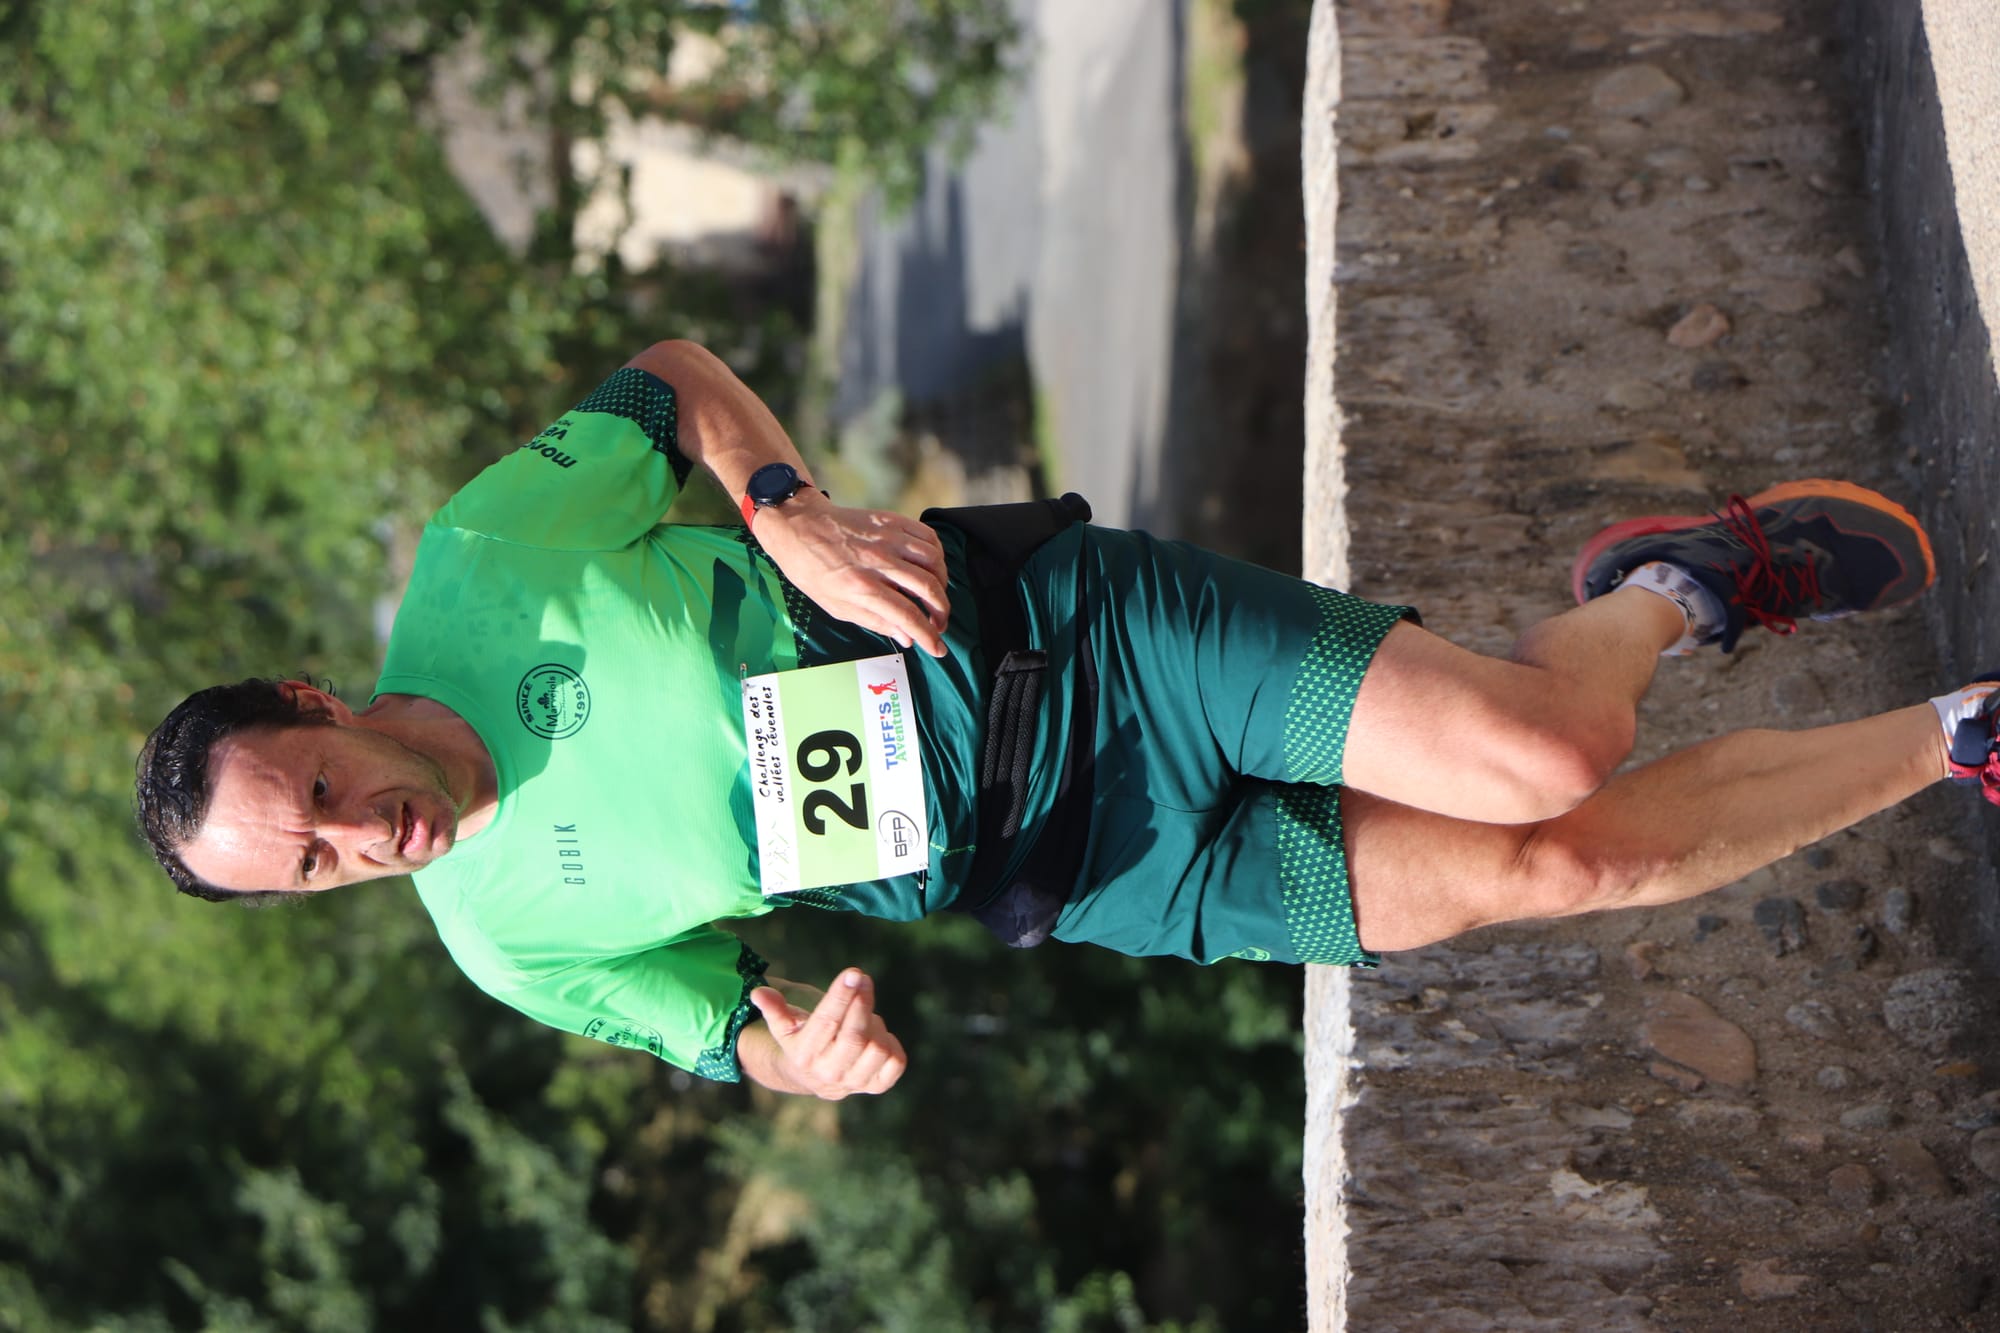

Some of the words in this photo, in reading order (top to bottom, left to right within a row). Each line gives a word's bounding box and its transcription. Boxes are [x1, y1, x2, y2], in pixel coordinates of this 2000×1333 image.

[521, 682, 535, 723] SINCE
[545, 676, 561, 727] Marvejols
[572, 680, 585, 720] 1991
[749, 696, 761, 719] des
[762, 686, 779, 746] cévenoles
[890, 692, 908, 763] Aventure
[754, 727, 770, 798] Challenge
[878, 702, 899, 770] TUFF'S
[770, 756, 785, 803] vallées
[796, 729, 870, 836] 29
[553, 823, 585, 885] GOBIK
[892, 816, 908, 858] BFP
